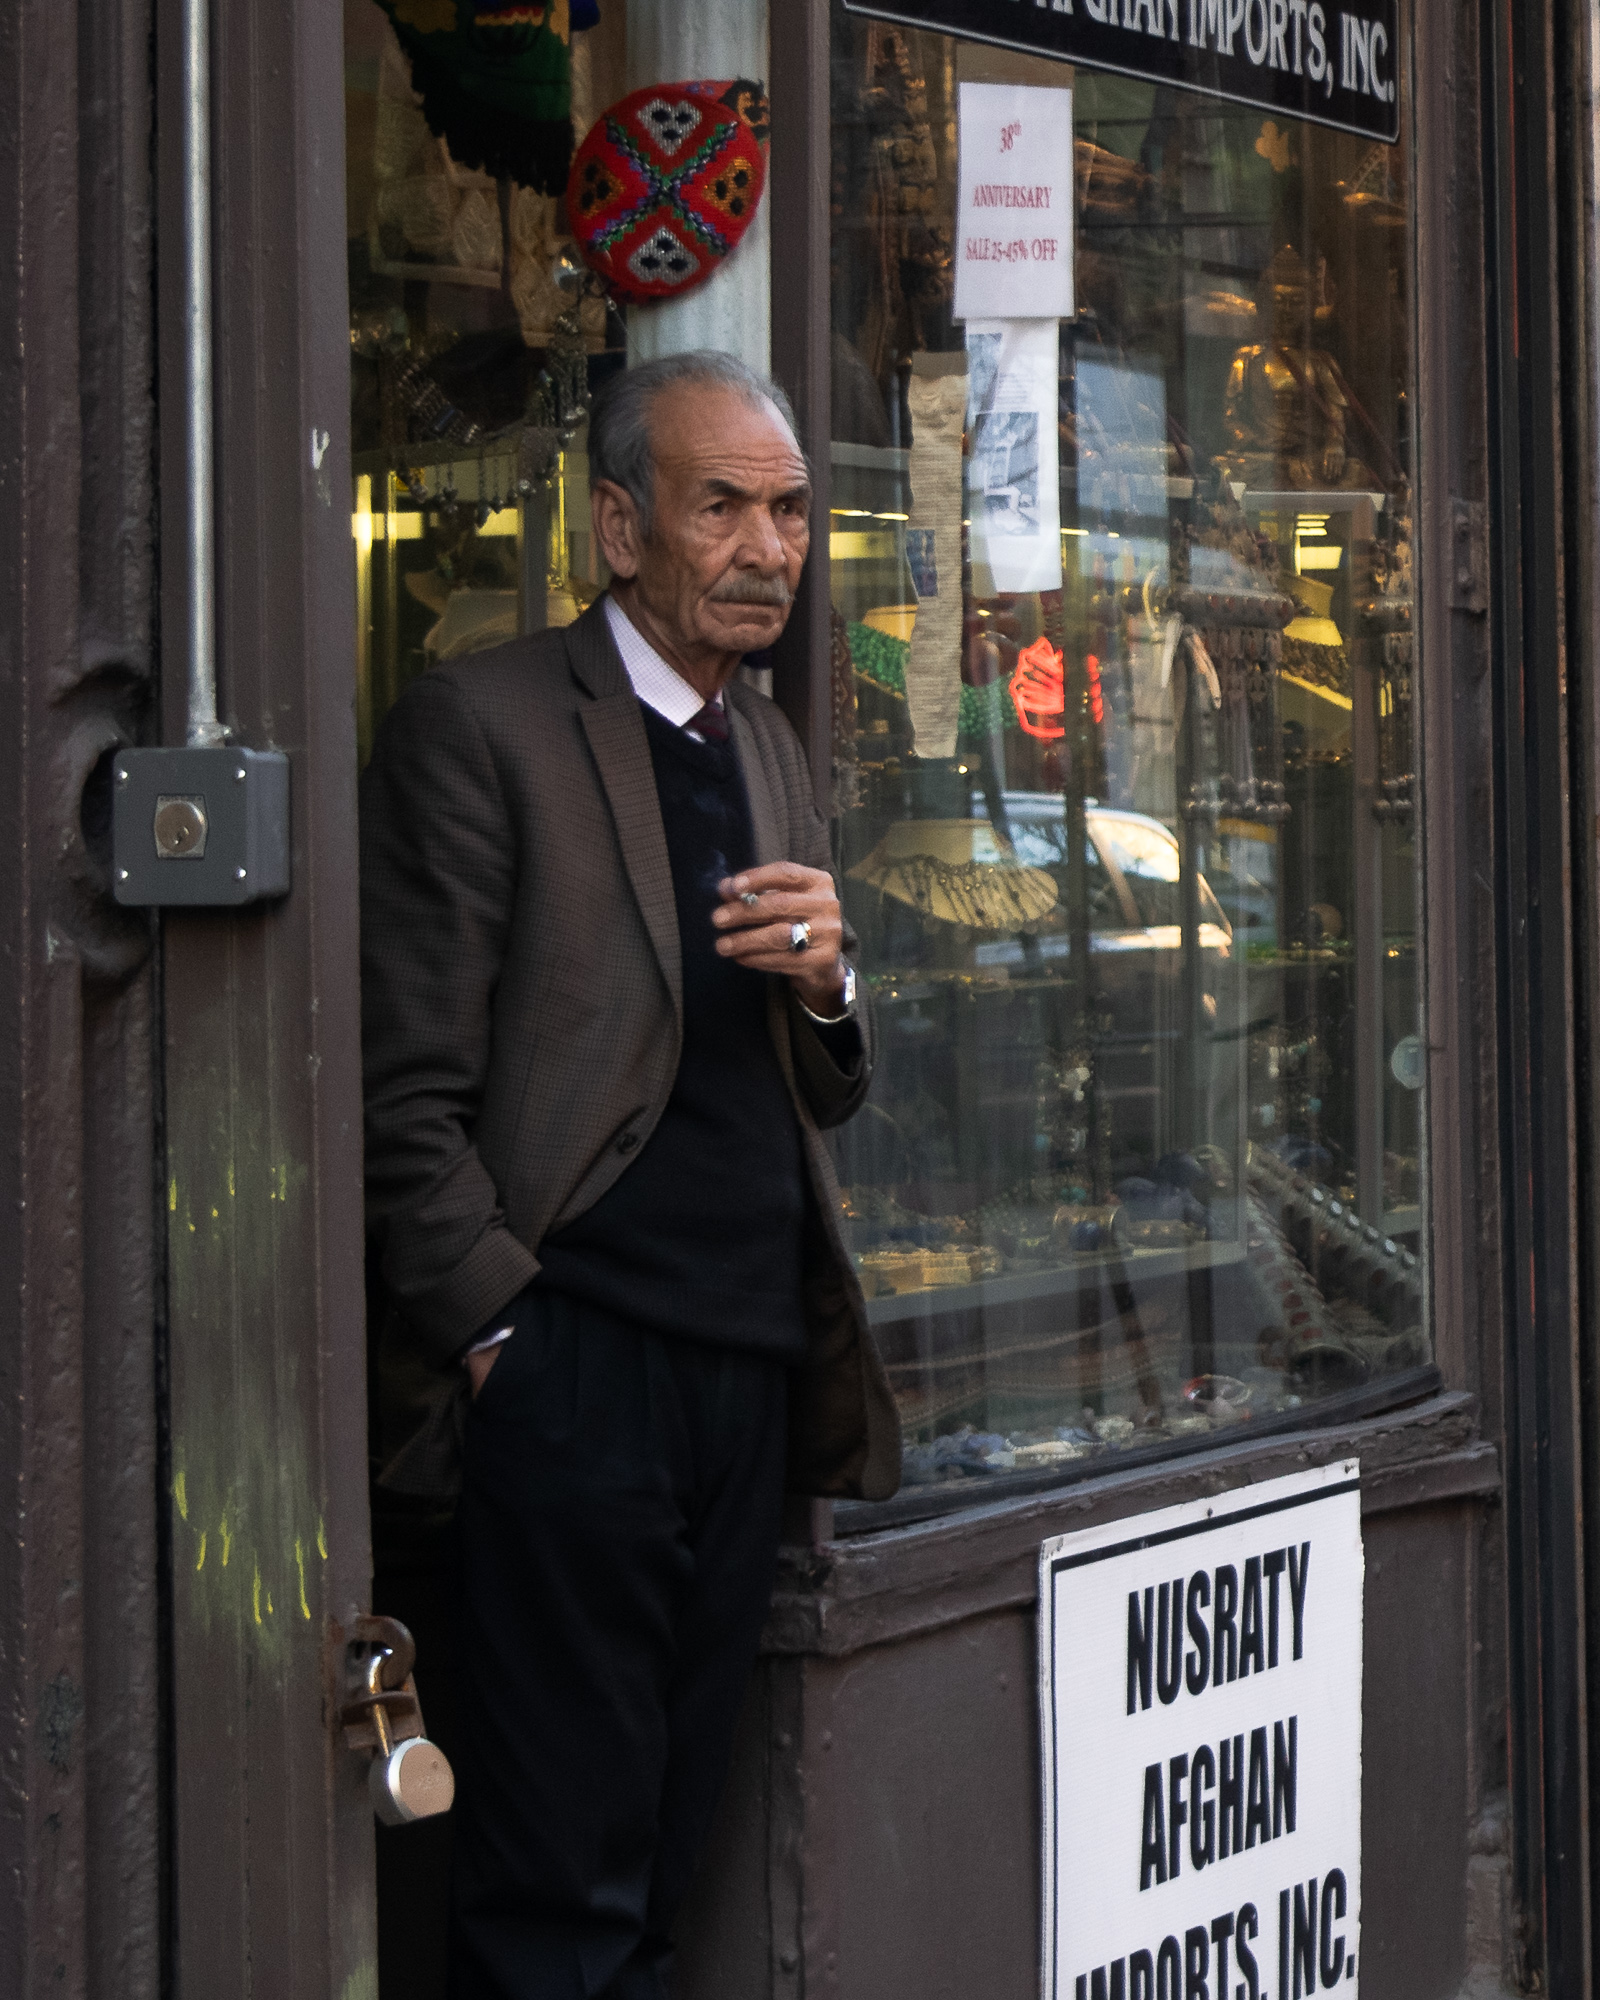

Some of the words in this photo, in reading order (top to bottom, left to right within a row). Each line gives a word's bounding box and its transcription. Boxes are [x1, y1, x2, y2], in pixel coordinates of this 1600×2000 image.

[1341, 12, 1396, 103] INC.
[966, 237, 990, 261] SALE
[1031, 237, 1058, 261] OFF
[1127, 1540, 1311, 1716] NUSRATY
[1139, 1715, 1297, 1892] AFGHAN
[1278, 1867, 1356, 2000] INC.
